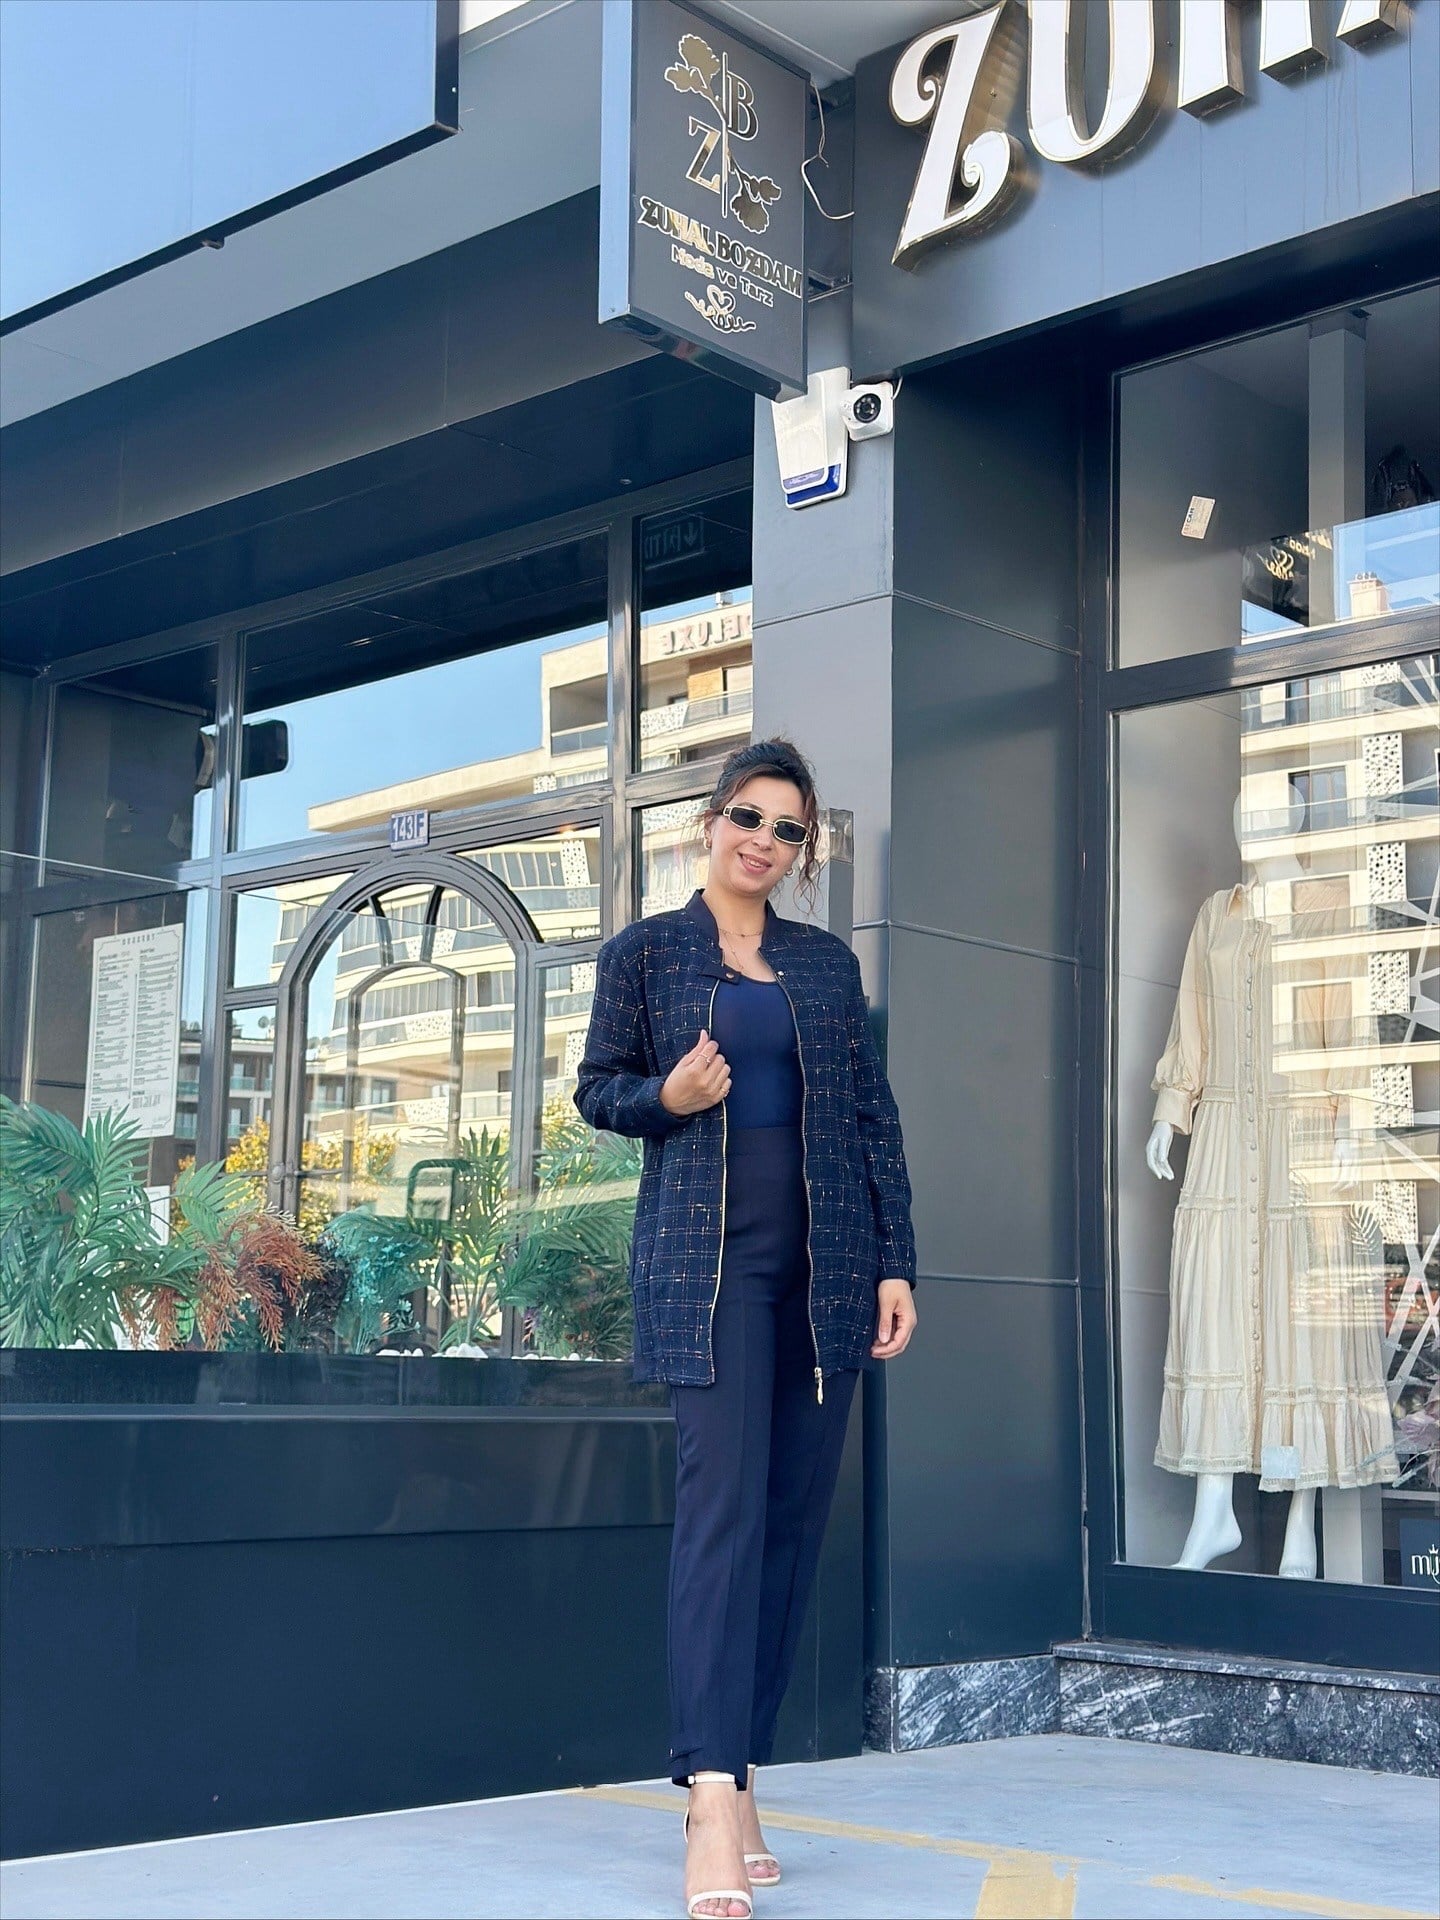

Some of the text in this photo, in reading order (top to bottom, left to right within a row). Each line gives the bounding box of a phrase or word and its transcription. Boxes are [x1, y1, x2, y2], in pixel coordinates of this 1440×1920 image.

[727, 71, 758, 140] B
[686, 115, 721, 195] Z
[637, 195, 803, 299] ZUHAL BOZDAM
[671, 243, 715, 280] Moda
[739, 275, 774, 308] Tarz
